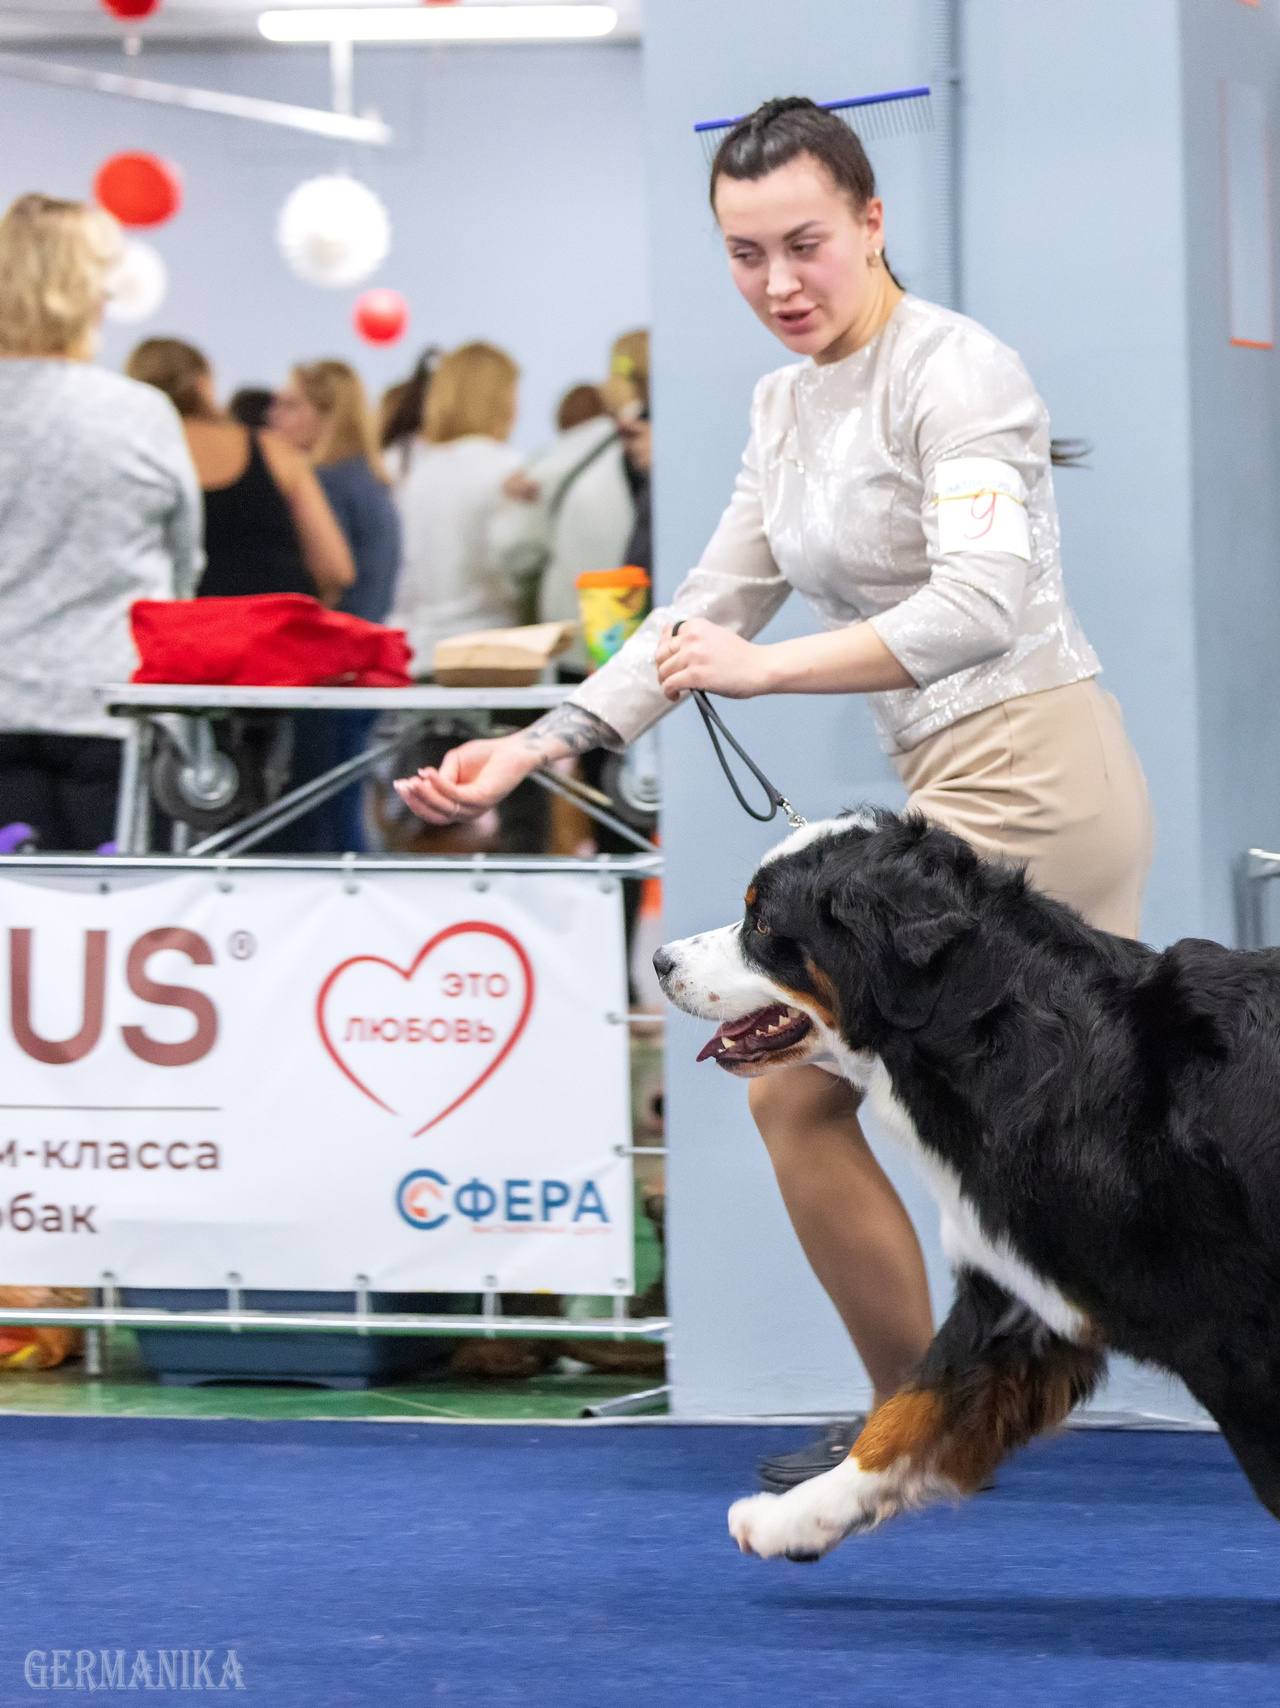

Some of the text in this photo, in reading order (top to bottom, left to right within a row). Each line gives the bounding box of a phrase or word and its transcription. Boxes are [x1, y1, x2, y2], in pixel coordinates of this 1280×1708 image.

[443, 972, 509, 998] ЭТО
[343, 1016, 496, 1043] ЛЮБОВЬ
[0, 1192, 98, 1234] бак
[396, 1169, 610, 1231] СФЕРА
